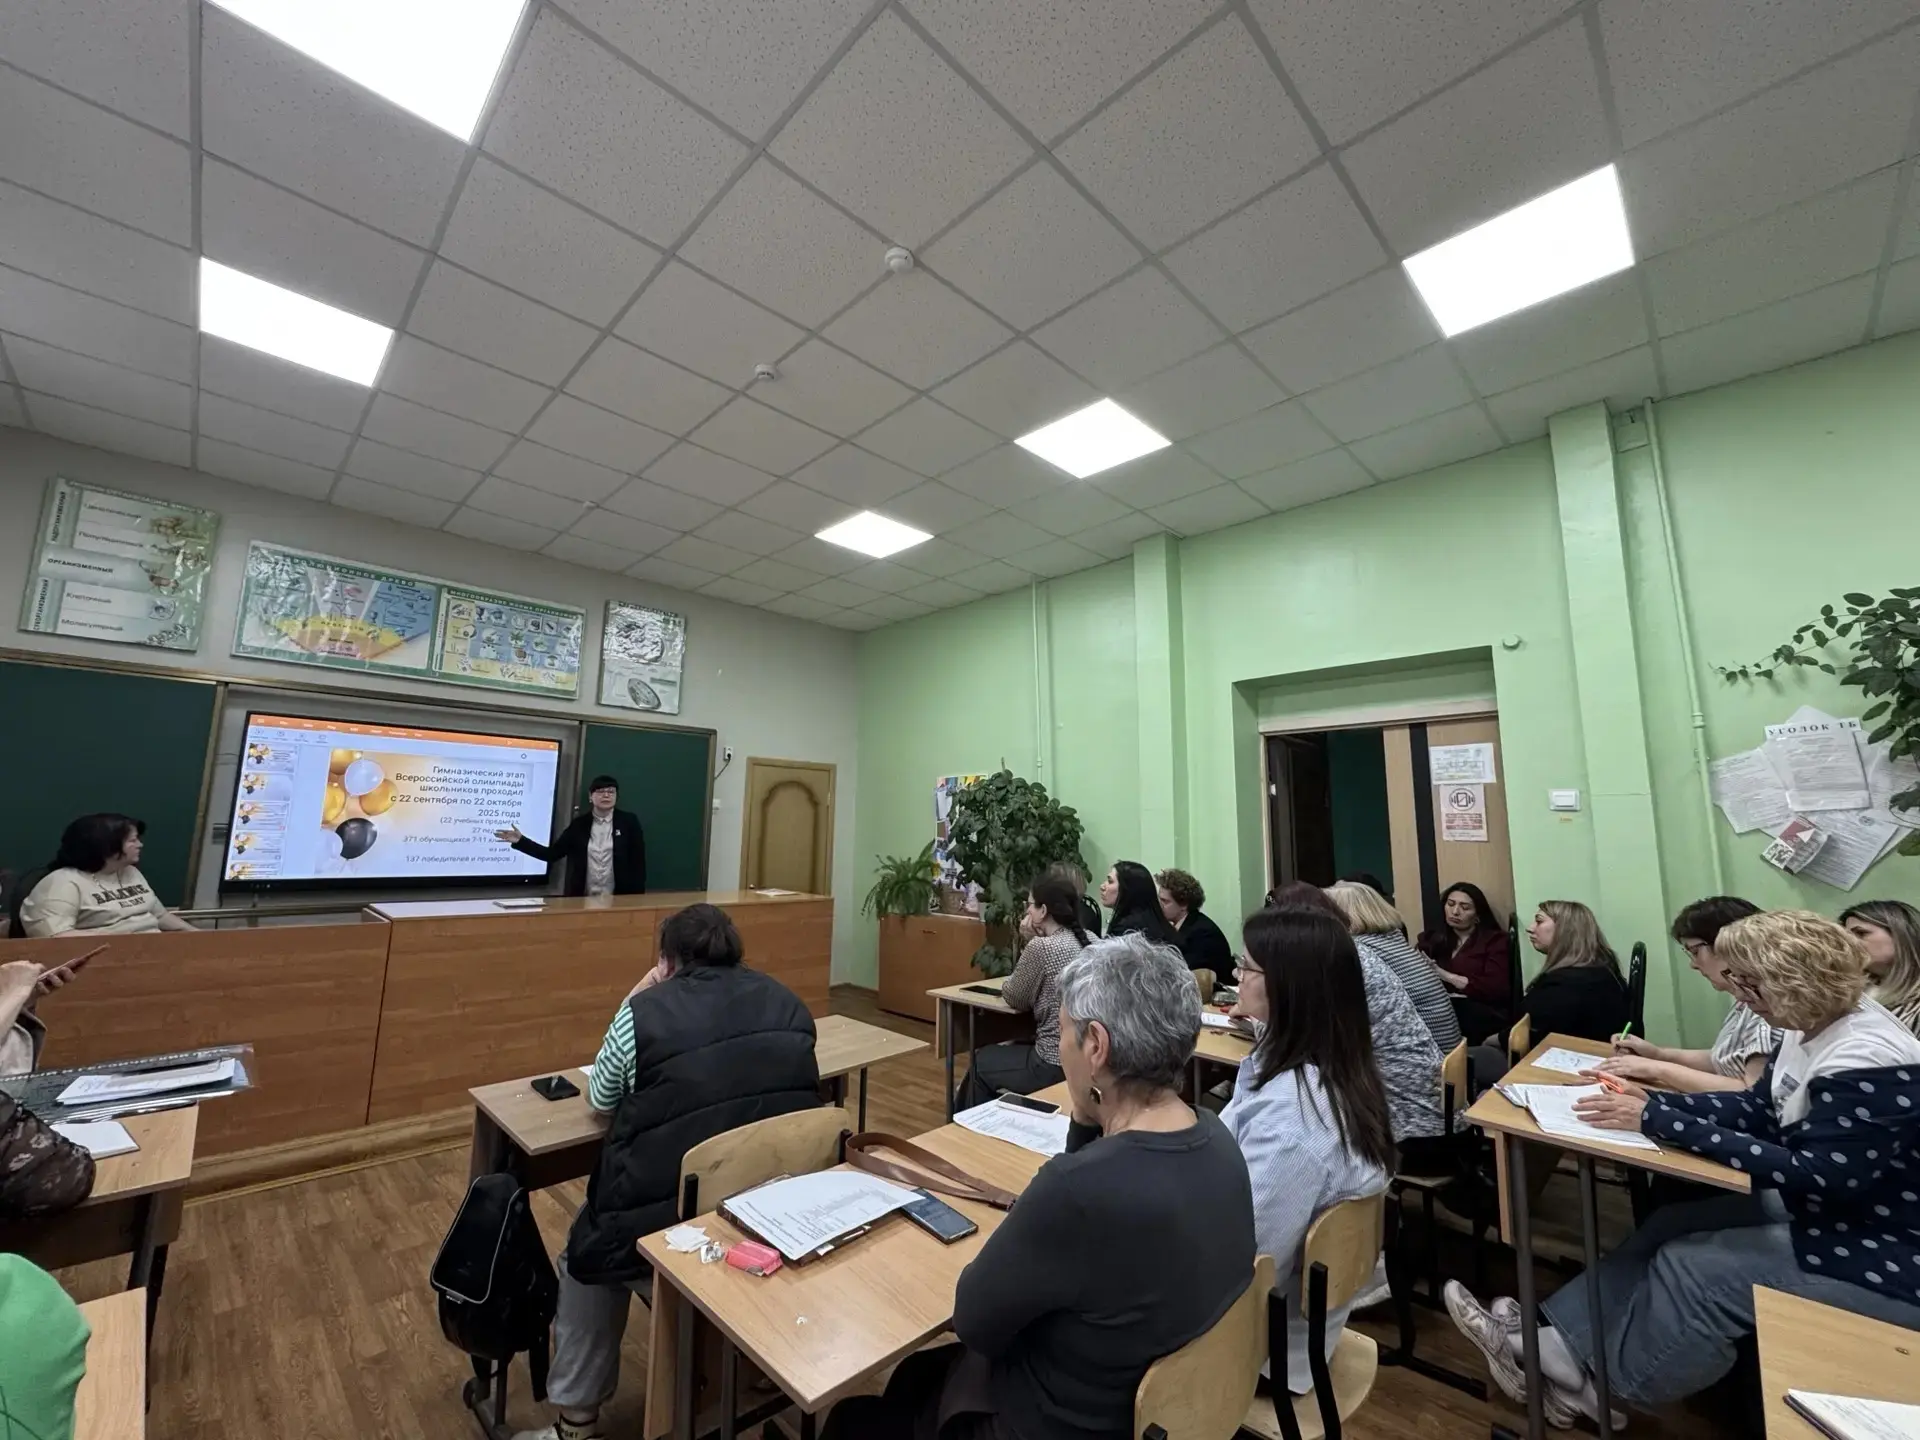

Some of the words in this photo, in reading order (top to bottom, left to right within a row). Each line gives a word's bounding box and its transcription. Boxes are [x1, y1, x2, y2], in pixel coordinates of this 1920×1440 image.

[1768, 724, 1830, 735] УГОЛОК
[433, 766, 503, 778] Гимназический
[506, 771, 526, 780] этап
[395, 772, 470, 785] Всероссийской
[472, 778, 525, 788] олимпиады
[420, 785, 479, 795] школьников
[481, 788, 524, 797] проходил
[399, 794, 411, 803] 22
[413, 796, 458, 806] сентября
[474, 798, 485, 806] 22
[487, 799, 522, 808] октября
[478, 809, 499, 817] 2025
